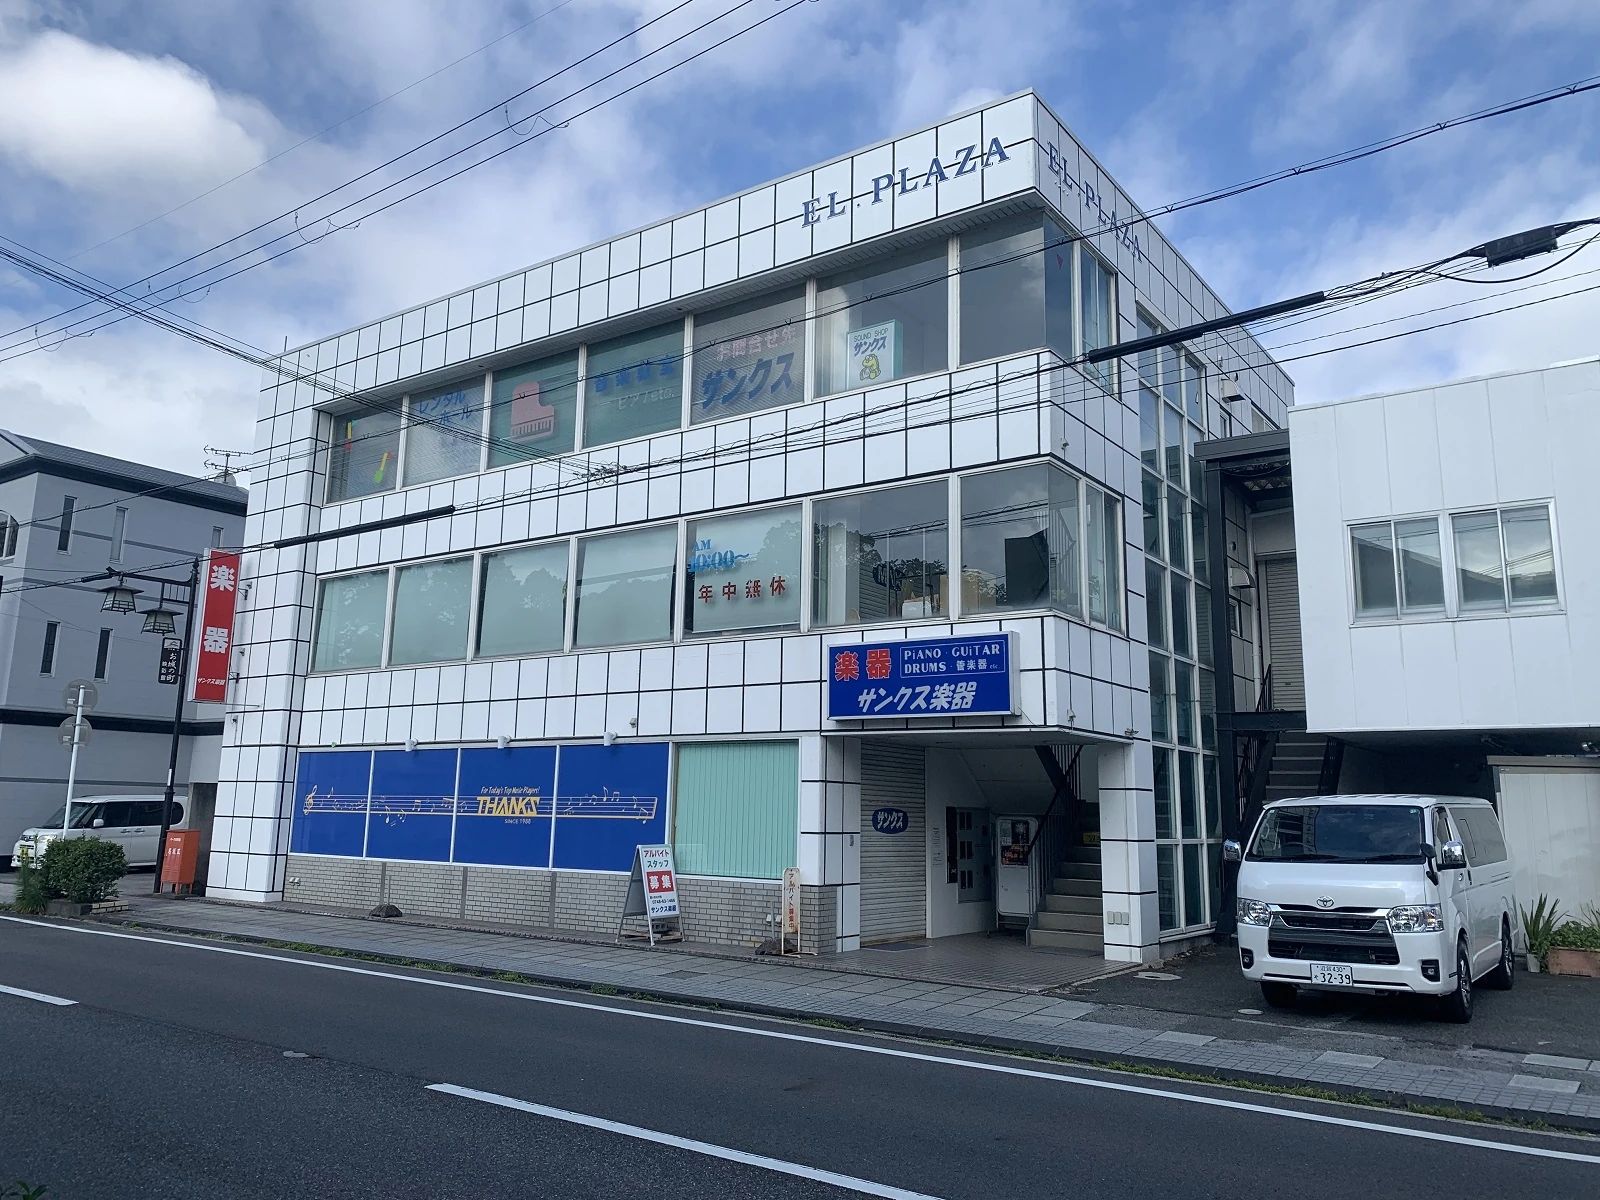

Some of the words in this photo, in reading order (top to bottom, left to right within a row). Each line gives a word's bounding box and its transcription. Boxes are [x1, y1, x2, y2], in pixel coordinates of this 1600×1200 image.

[871, 136, 1010, 206] PLAZA
[1085, 181, 1143, 263] PLAZA
[853, 332, 872, 343] SOUND
[874, 327, 889, 338] SHOP
[853, 335, 888, 357] サンクス
[702, 351, 795, 410] サンクス
[691, 538, 712, 552] AM
[203, 564, 236, 655] 楽器
[834, 648, 892, 682] 楽器
[903, 661, 947, 674] DRUMS
[956, 658, 988, 672] 管楽器
[857, 681, 978, 713] サンクス楽器
[476, 796, 541, 817] THANKS
[877, 811, 904, 830] サンクス
[643, 849, 670, 858] アルバイト
[647, 859, 669, 869] スタッフ
[649, 874, 672, 890] 募集
[1320, 973, 1351, 984] 32-39
